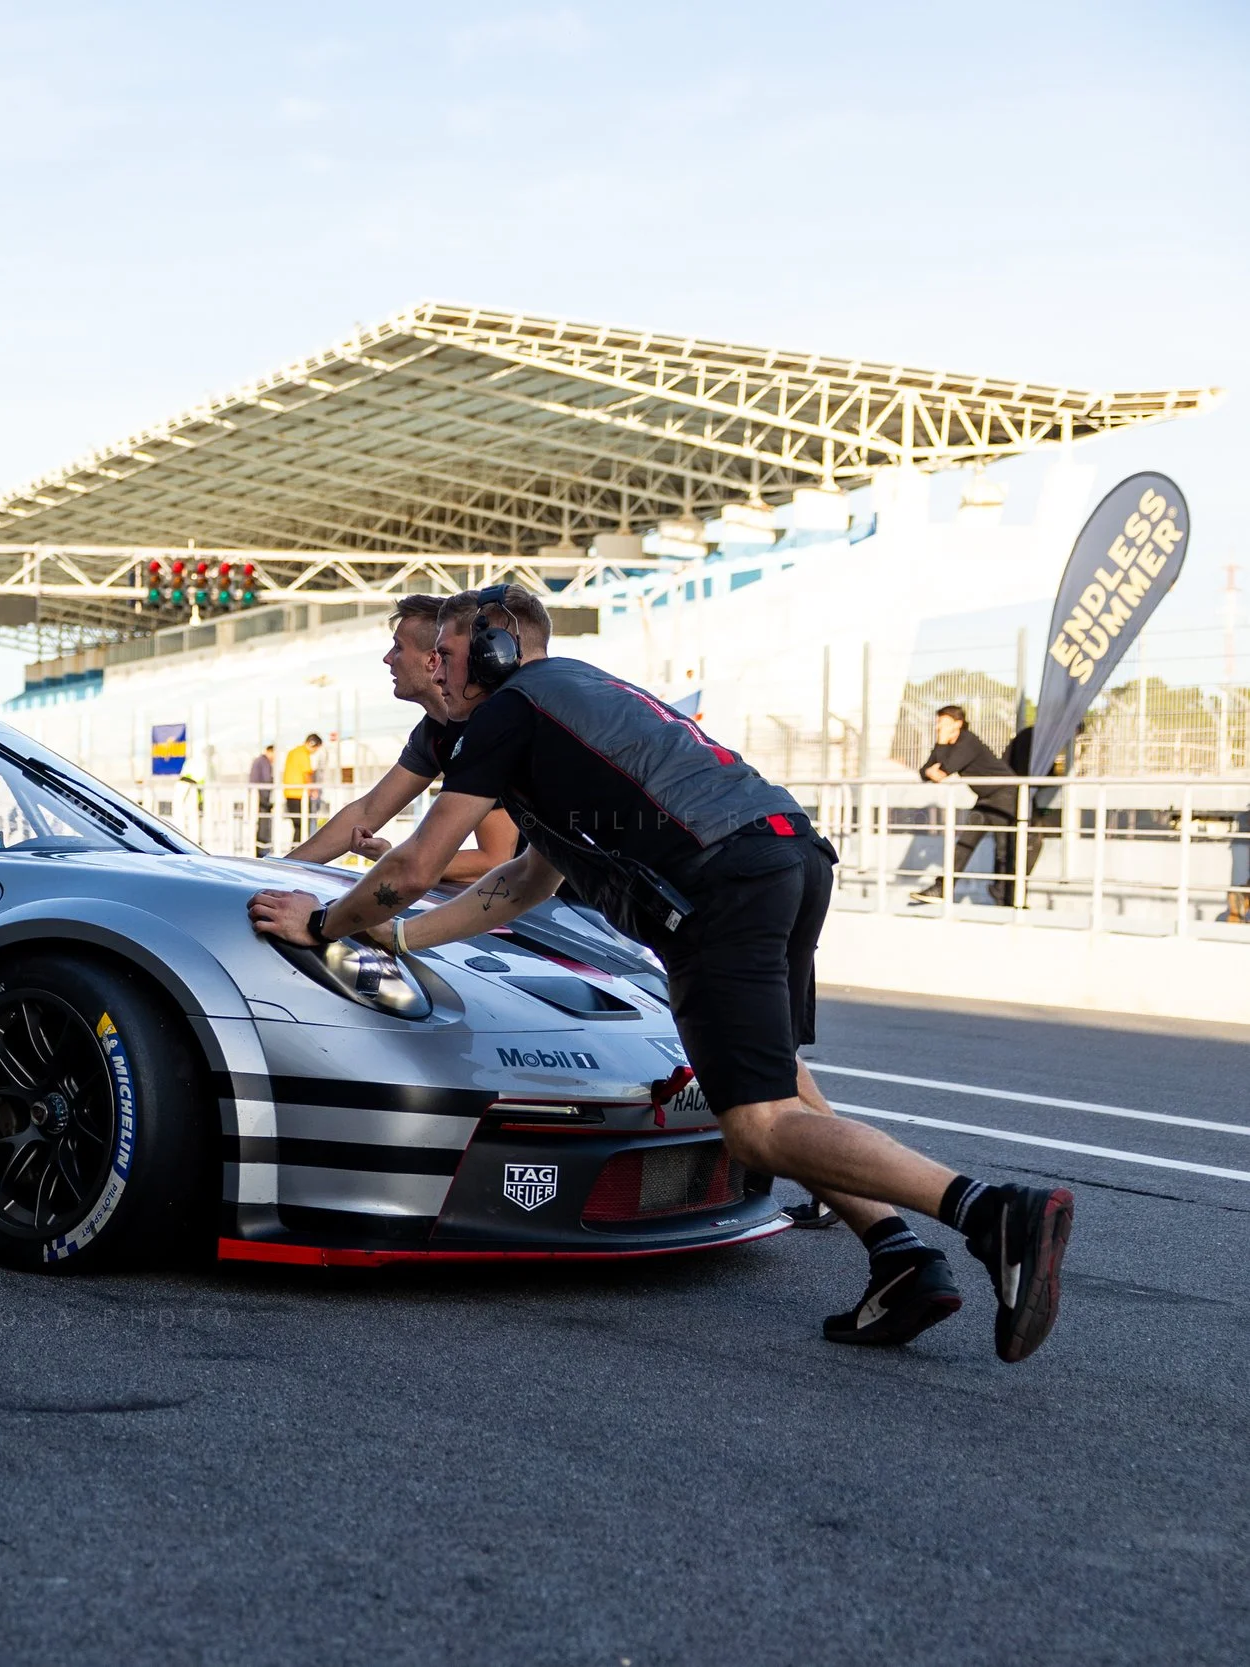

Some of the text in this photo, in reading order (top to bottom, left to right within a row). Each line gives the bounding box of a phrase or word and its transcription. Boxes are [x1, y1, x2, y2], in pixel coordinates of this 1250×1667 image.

[1049, 487, 1167, 667] ENDLESS
[496, 1047, 573, 1068] Mobil
[81, 1055, 134, 1238] MICHELIN PILOT SPORT
[510, 1167, 553, 1181] TAG
[507, 1184, 554, 1206] HEUER
